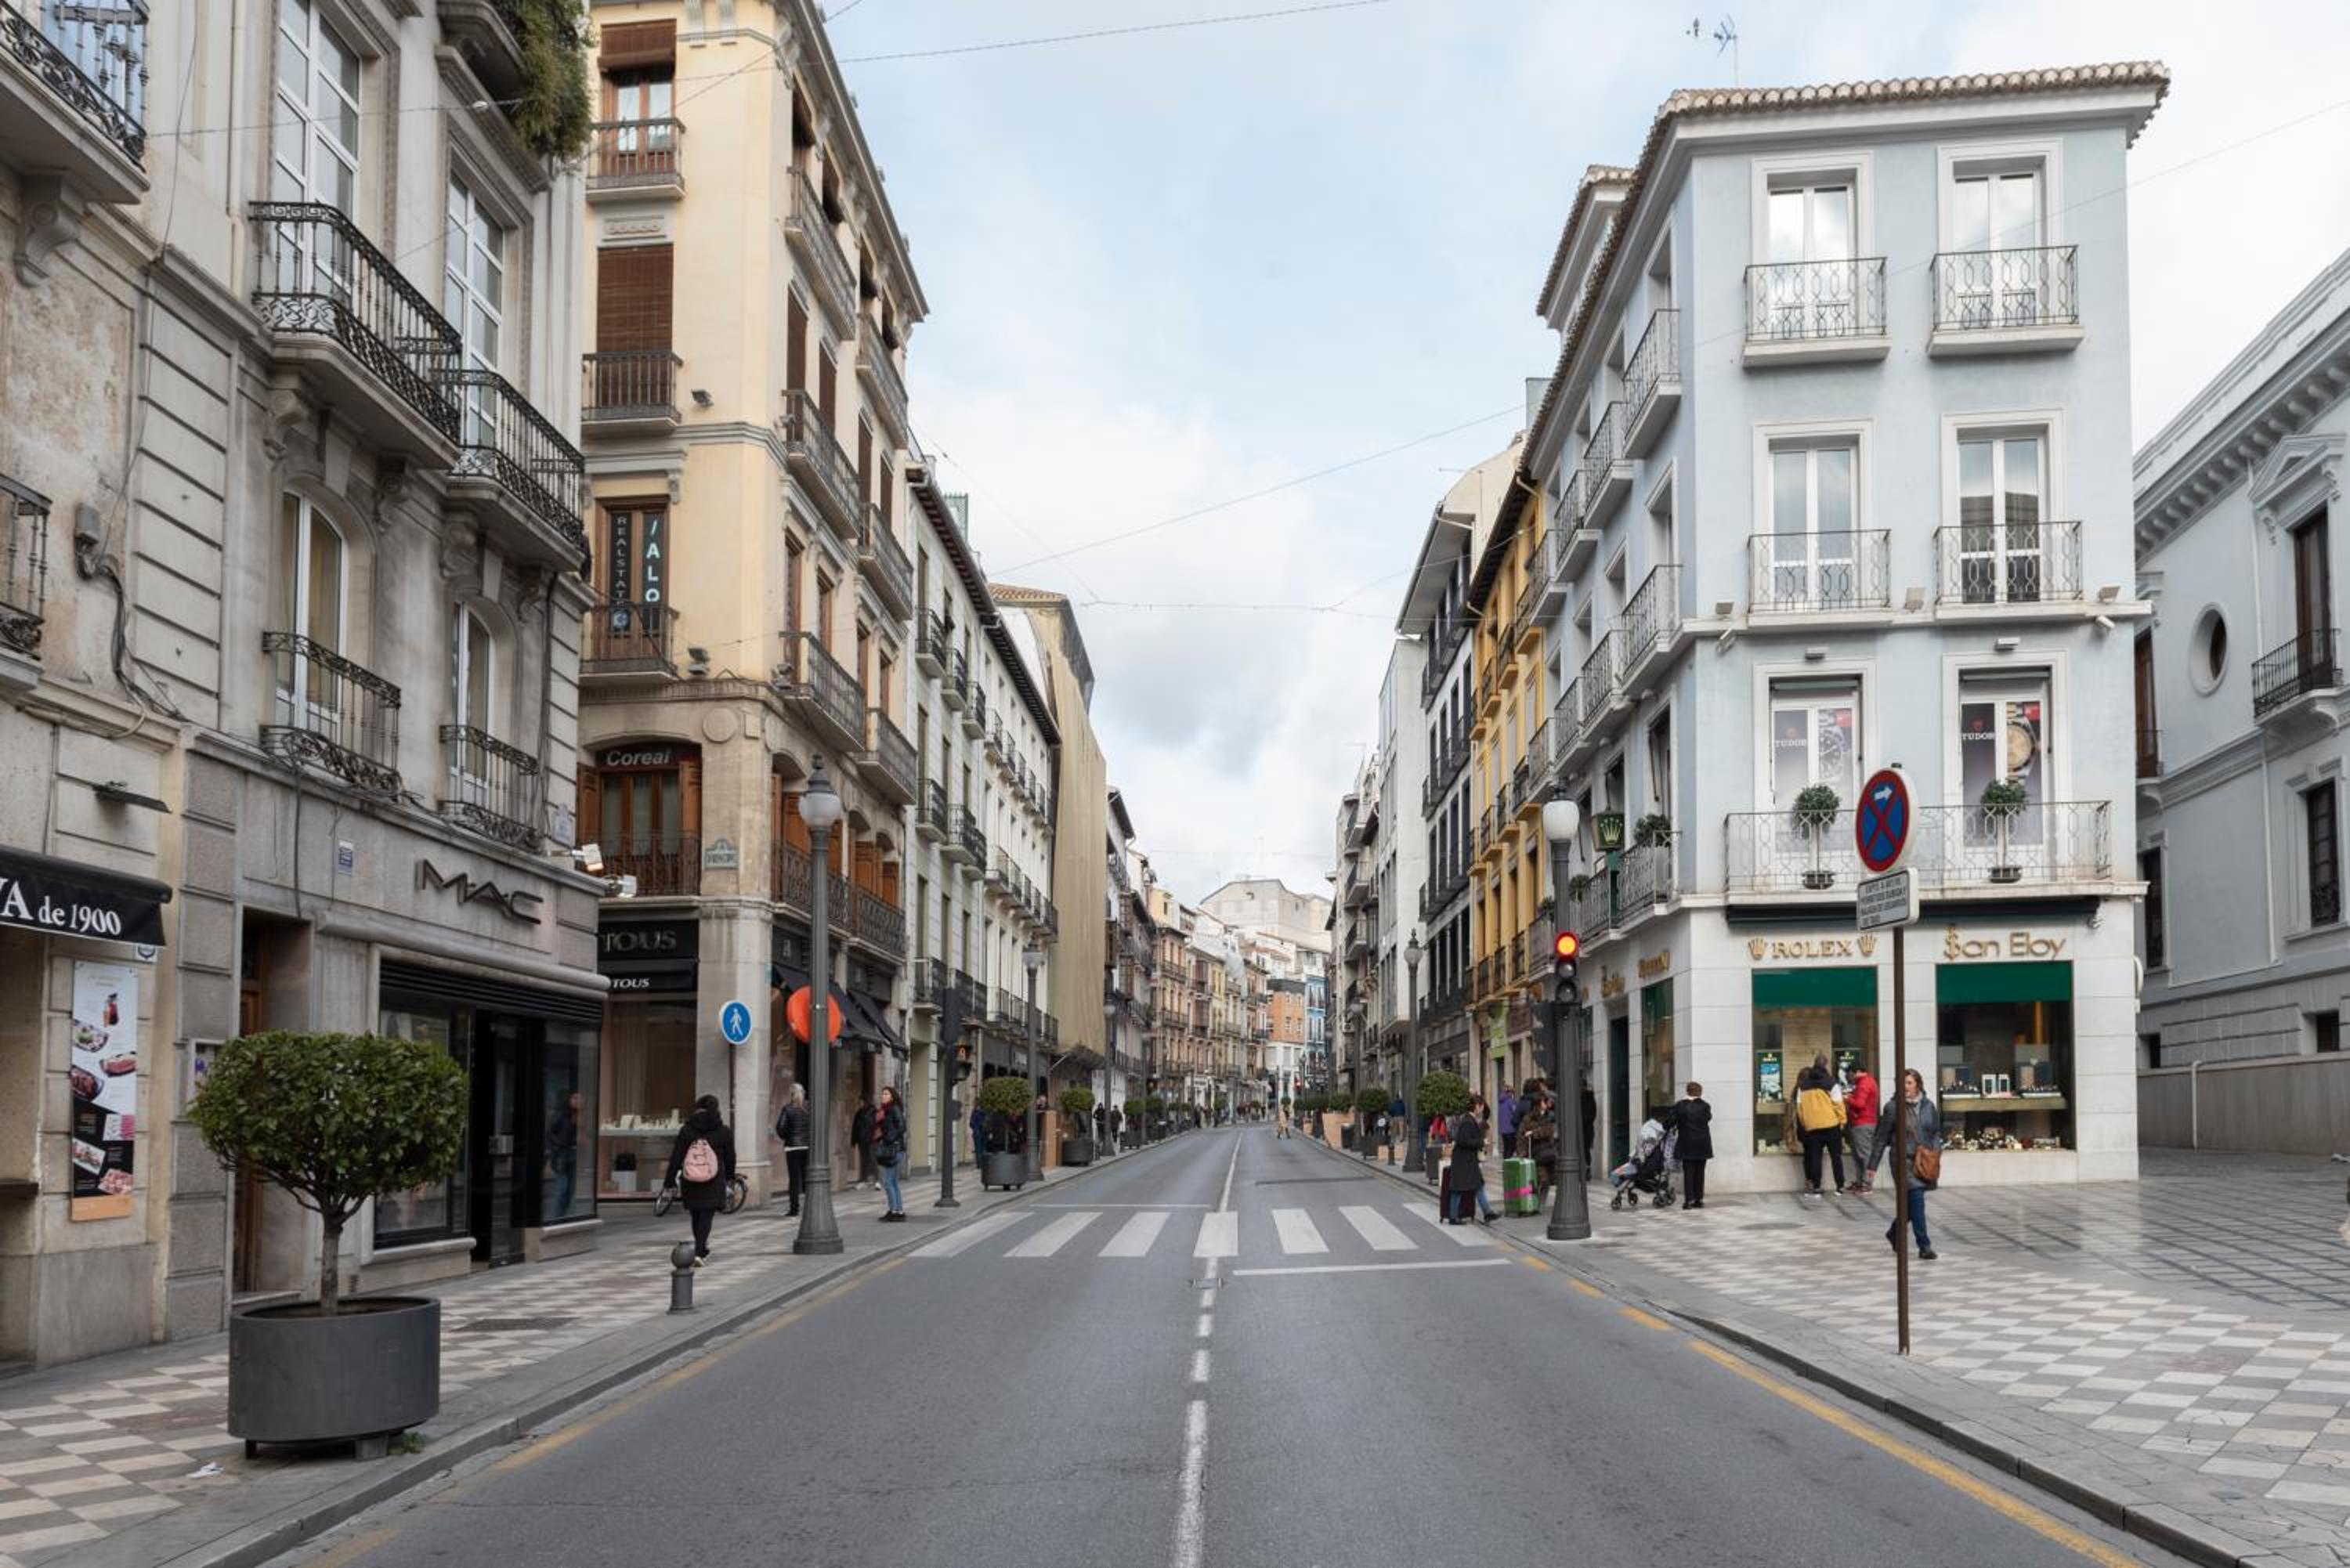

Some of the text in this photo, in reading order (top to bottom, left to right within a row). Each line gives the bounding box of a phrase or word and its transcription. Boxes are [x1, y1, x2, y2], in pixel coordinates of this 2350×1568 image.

[607, 748, 671, 766] Coreal
[38, 895, 66, 926] de
[69, 904, 121, 935] 1900
[598, 930, 677, 952] TOUS
[1772, 939, 1853, 959] ROLEX
[2009, 931, 2067, 961] Eloy
[613, 977, 649, 988] TOUS
